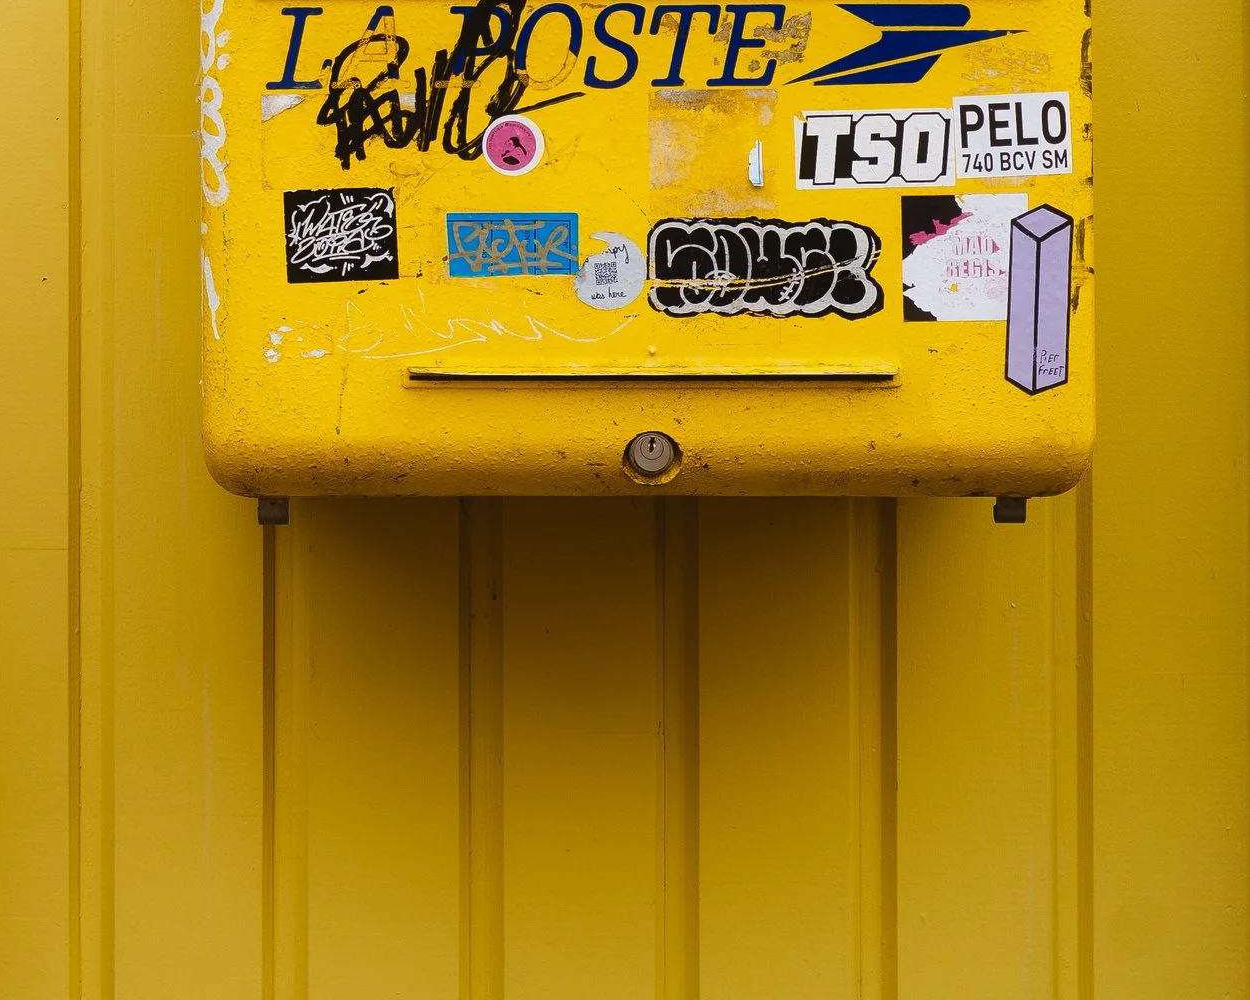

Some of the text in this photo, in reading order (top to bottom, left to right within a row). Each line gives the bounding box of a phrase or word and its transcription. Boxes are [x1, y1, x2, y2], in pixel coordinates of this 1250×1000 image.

[435, 2, 787, 89] POSTE
[799, 111, 951, 186] TSO
[959, 99, 1068, 149] PELO
[962, 148, 1069, 173] 740 BCV SM
[591, 286, 627, 300] was here
